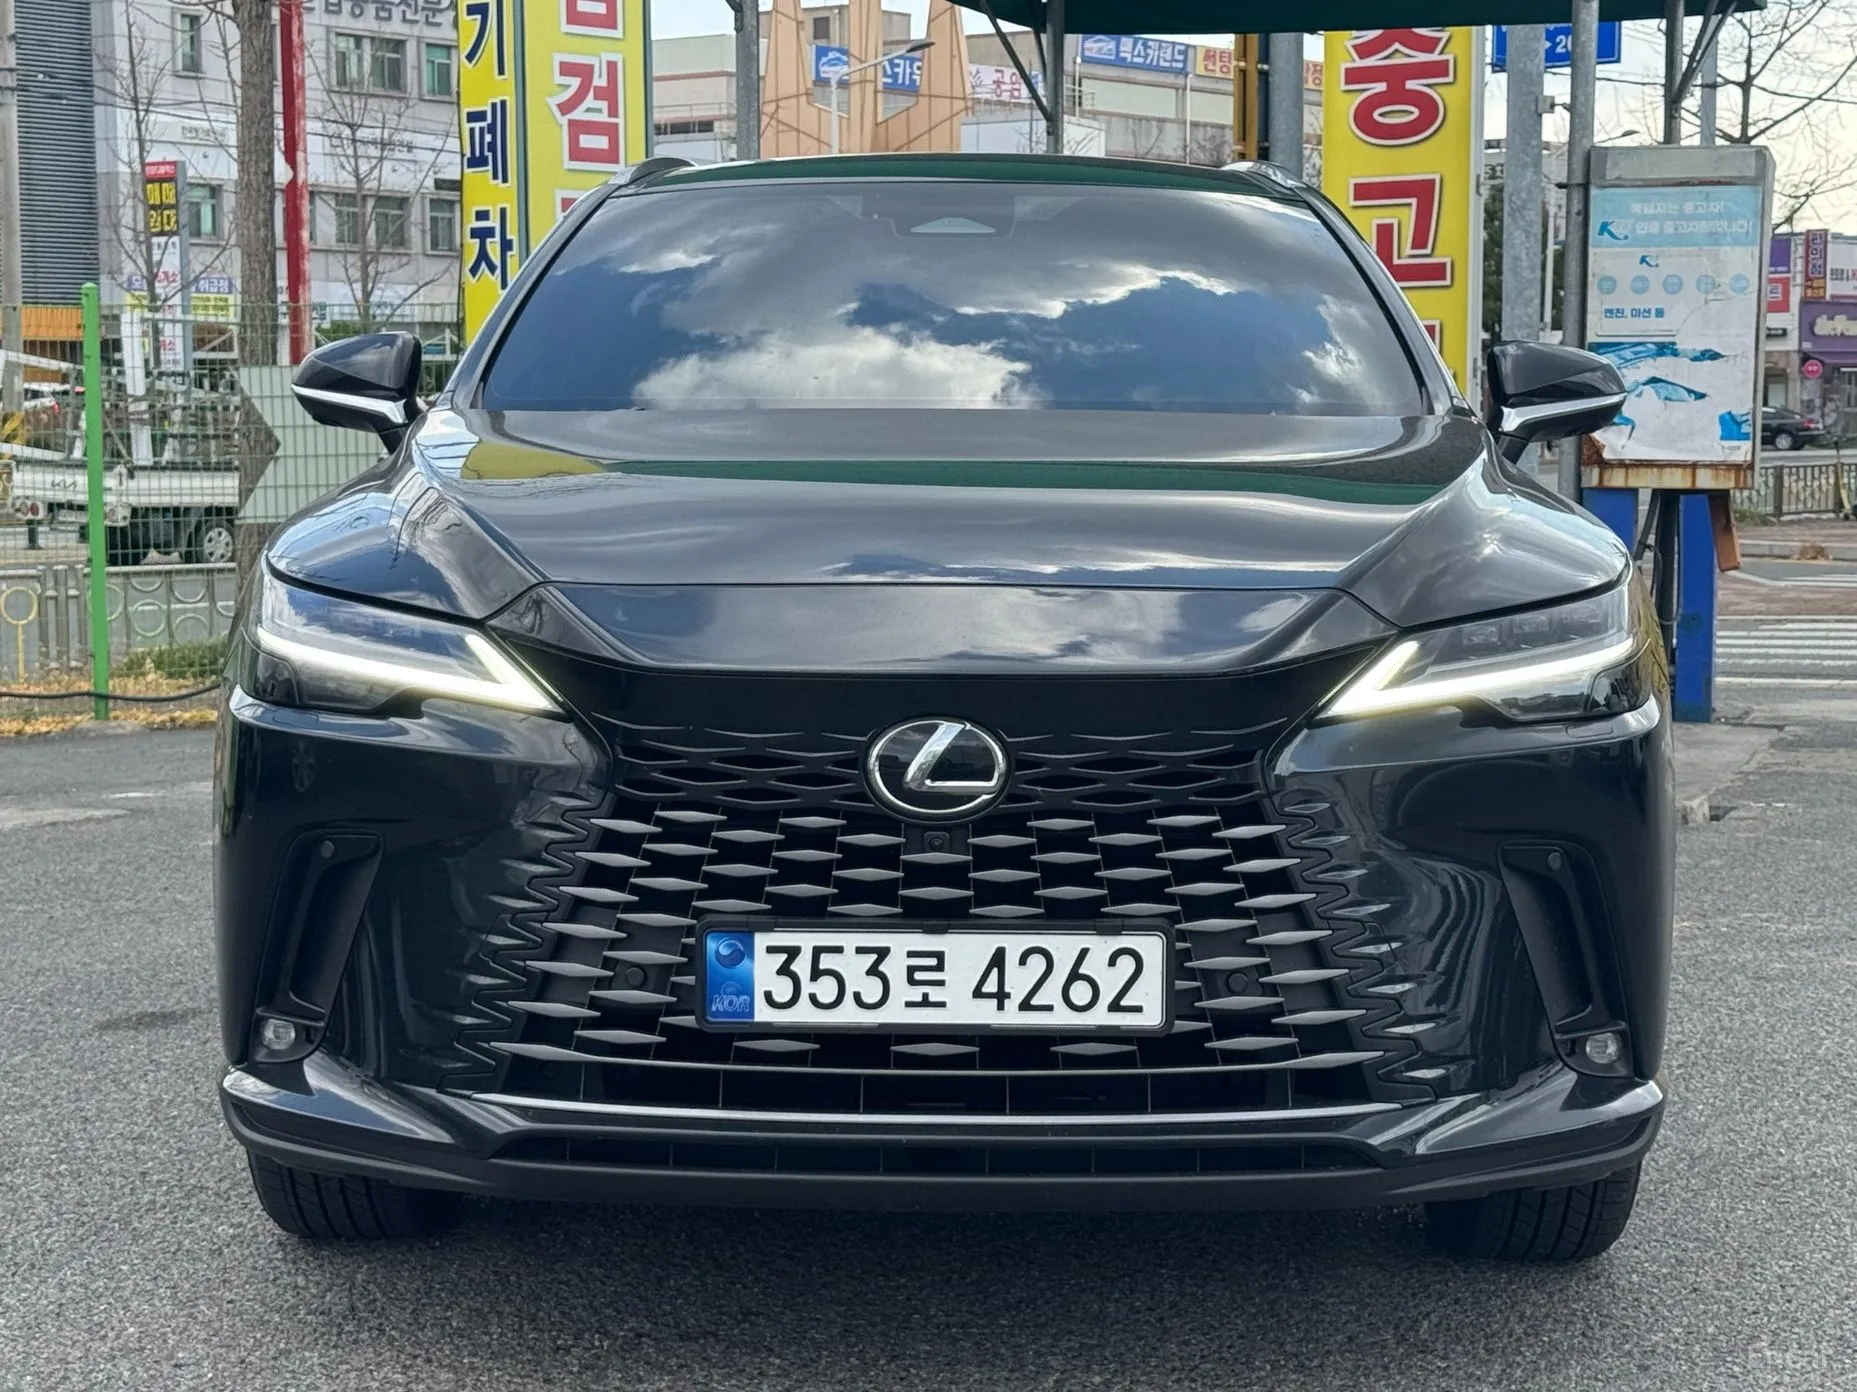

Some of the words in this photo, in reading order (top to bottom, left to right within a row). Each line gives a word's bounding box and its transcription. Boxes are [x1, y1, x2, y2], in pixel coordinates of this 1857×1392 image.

[1604, 308, 1628, 319] 엔진,
[1631, 308, 1651, 319] 미션
[763, 944, 947, 1010] 353로
[972, 945, 1144, 1013] 4262
[711, 994, 750, 1012] KOR
